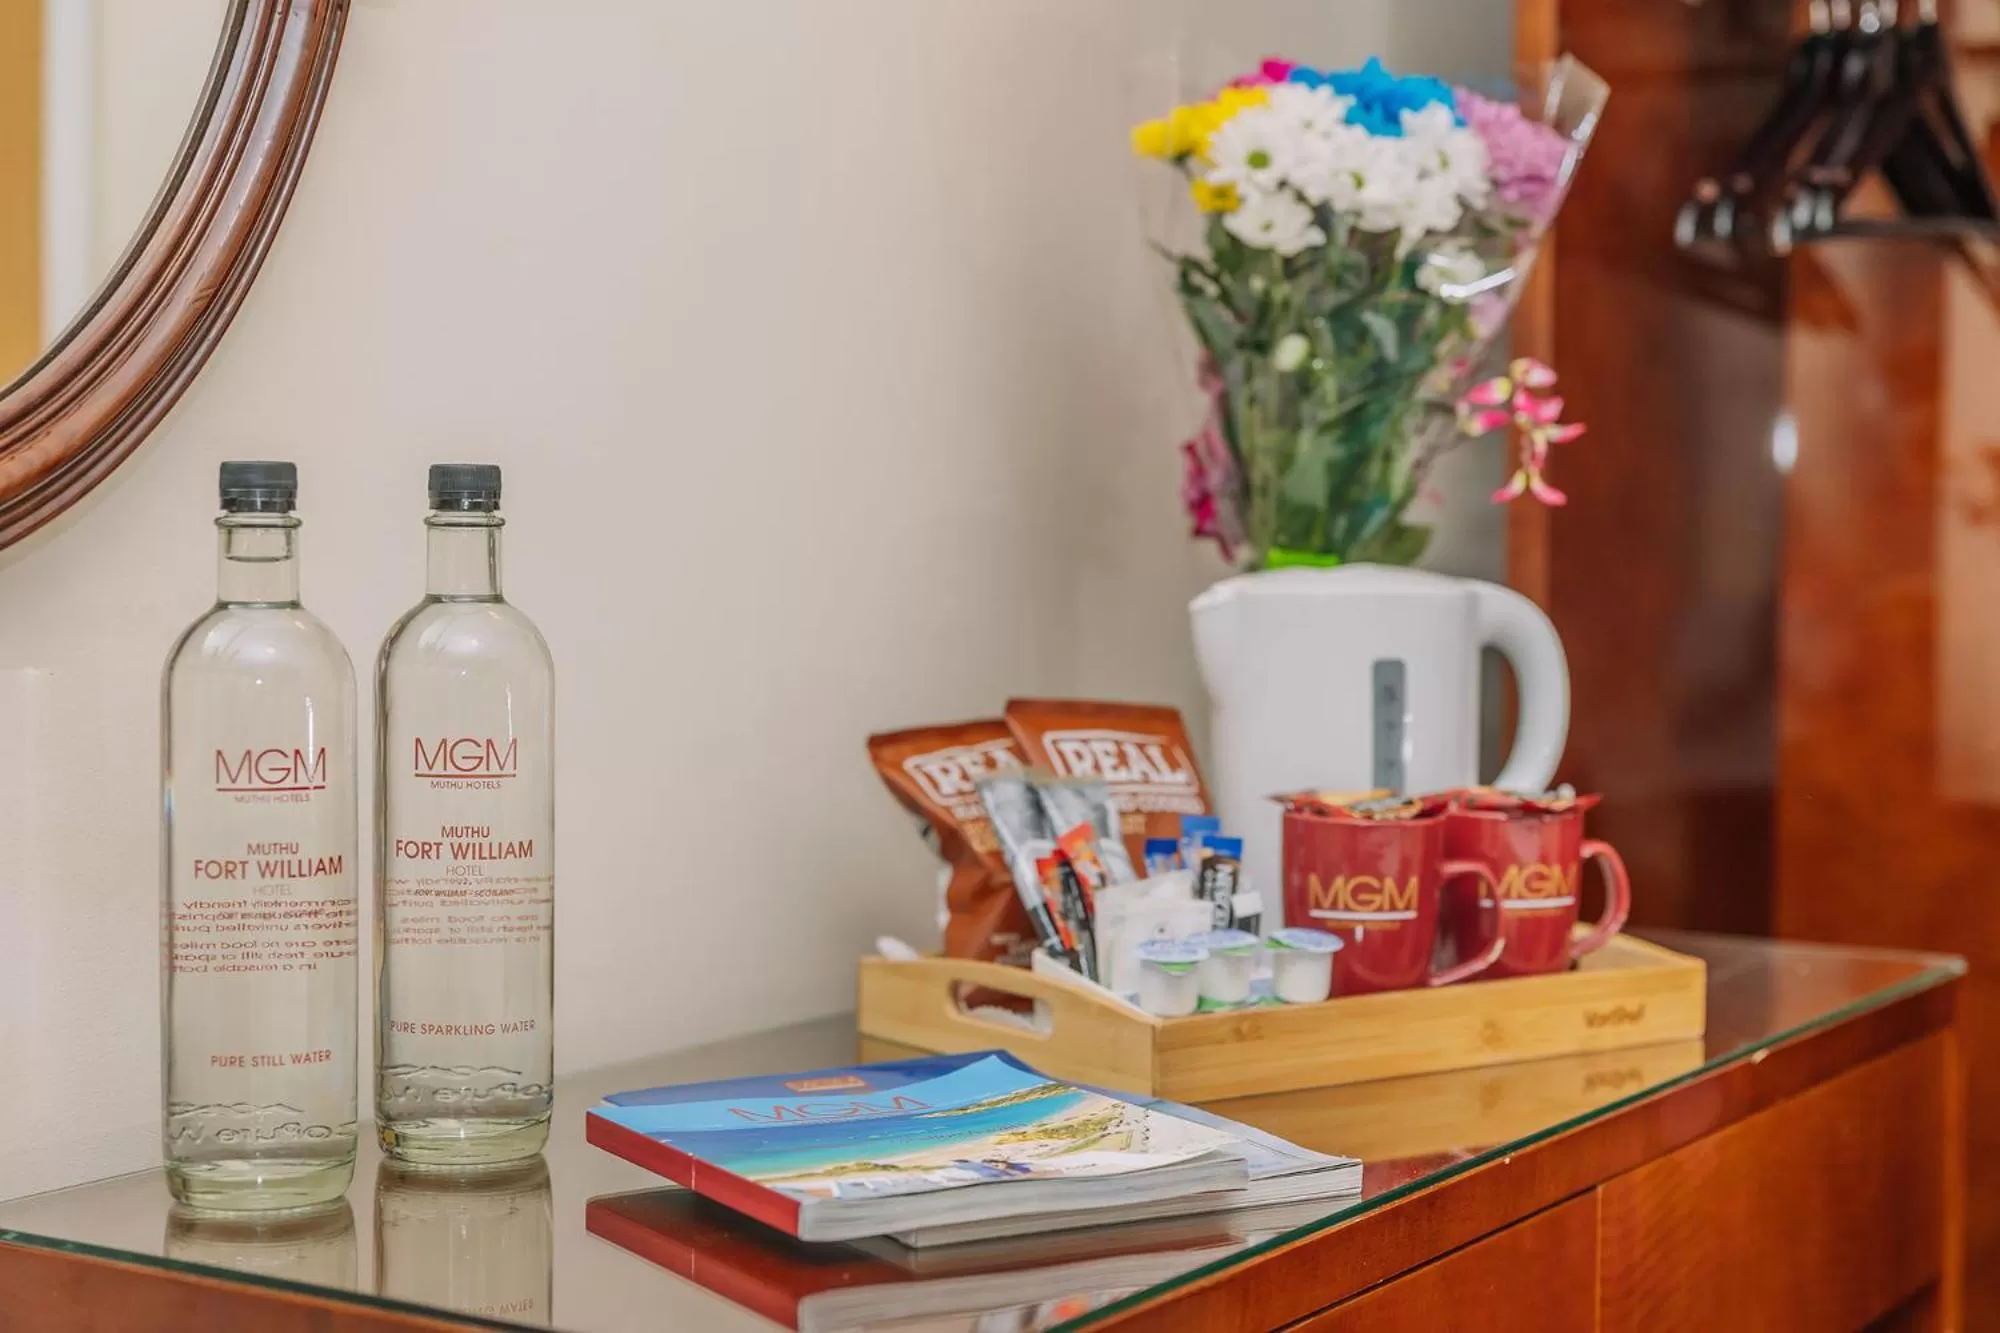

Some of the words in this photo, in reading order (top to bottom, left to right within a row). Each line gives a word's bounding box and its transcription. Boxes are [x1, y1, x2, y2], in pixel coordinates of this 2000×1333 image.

[414, 737, 517, 772] MGM
[1057, 737, 1189, 784] REAL
[216, 747, 326, 785] MGM
[430, 780, 463, 790] MUTHU
[465, 780, 502, 790] HOTELS
[234, 794, 271, 804] MUTHU
[272, 793, 312, 803] HOTELS
[441, 826, 491, 838] MUTHU
[247, 842, 300, 856] MUTHU
[395, 840, 443, 860] FORT
[450, 840, 533, 860] WILLIAM
[194, 859, 249, 881] FORT
[258, 855, 343, 879] WILLIAM
[446, 864, 485, 877] HOTEL
[1478, 862, 1577, 898] MGM
[252, 884, 293, 897] HOTEL
[1308, 872, 1420, 912] MGM
[389, 1020, 417, 1035] PURE
[420, 1022, 496, 1037] SPARKLING
[501, 1018, 536, 1035] WATER
[211, 1055, 246, 1069] PURE
[250, 1053, 286, 1067] STILL
[290, 1049, 333, 1065] WATER
[727, 1095, 935, 1121] MGM
